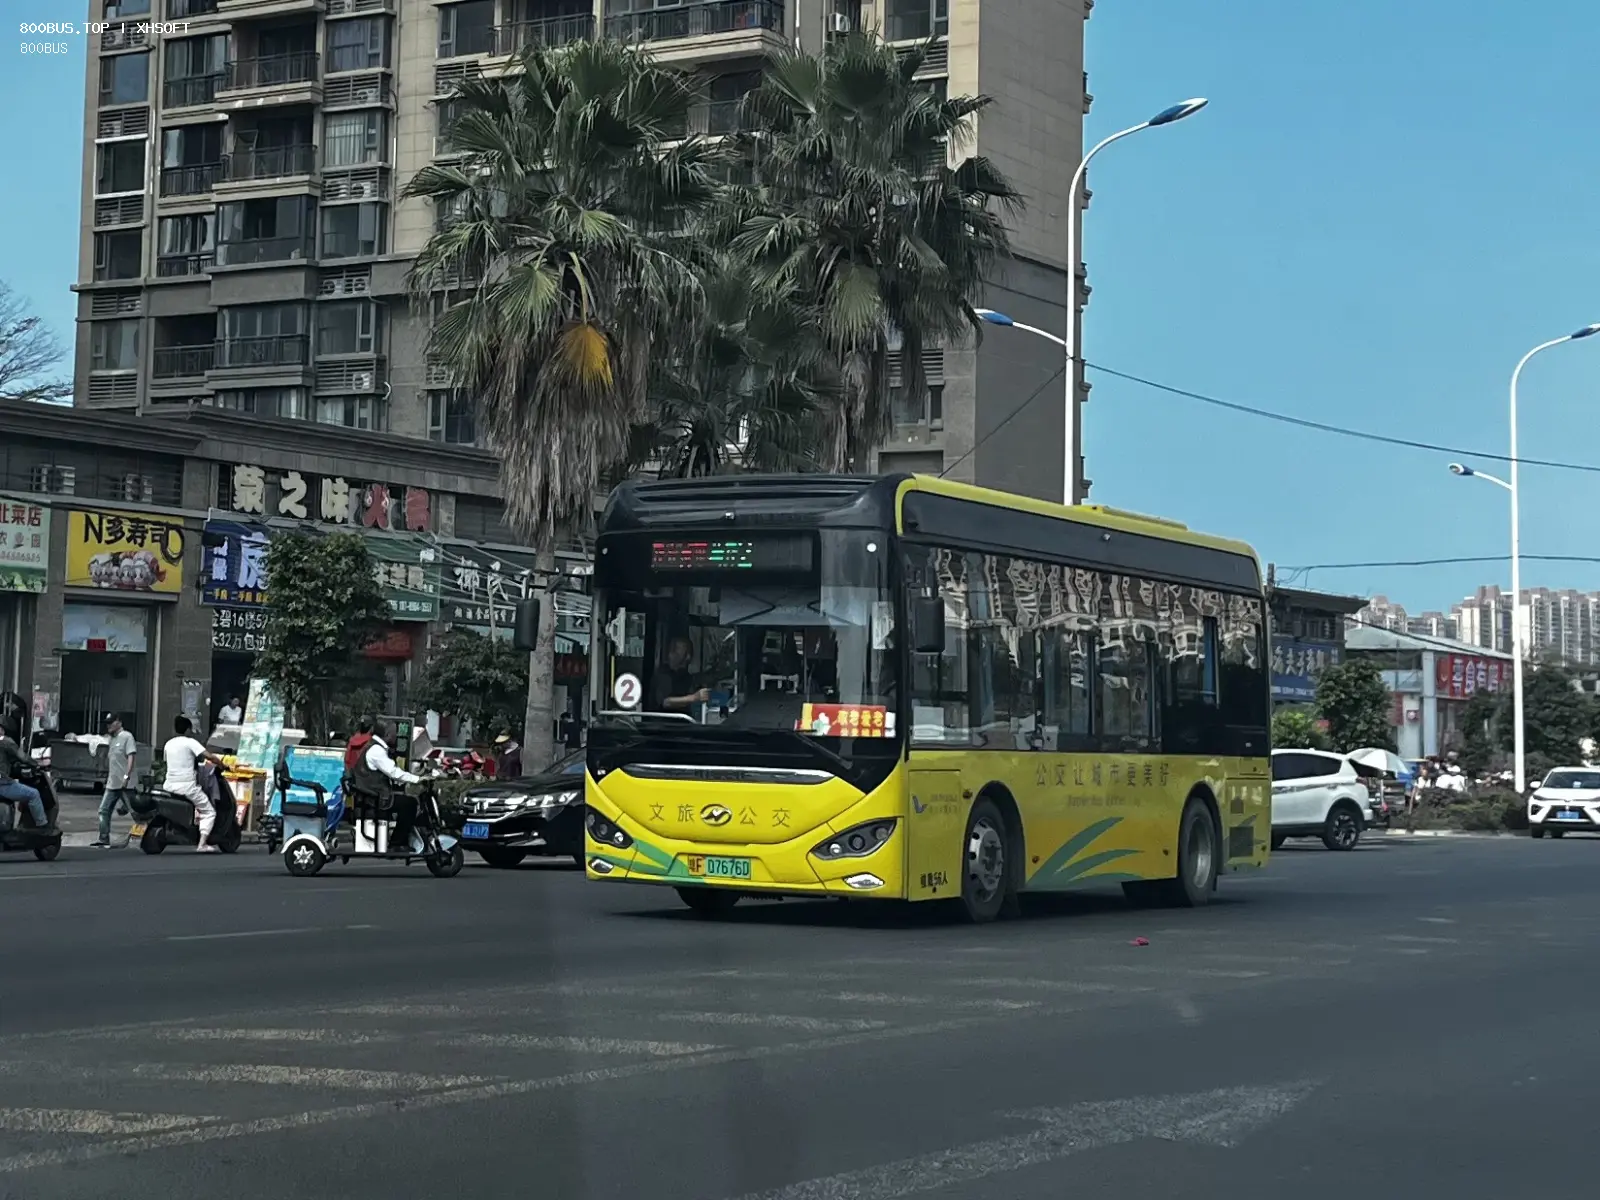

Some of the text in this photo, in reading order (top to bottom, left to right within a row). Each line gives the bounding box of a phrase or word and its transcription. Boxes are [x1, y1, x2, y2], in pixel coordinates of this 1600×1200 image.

[620, 679, 635, 702] 2
[1036, 760, 1170, 788] 公交让城市更美好
[649, 801, 791, 828] 文旅 公交
